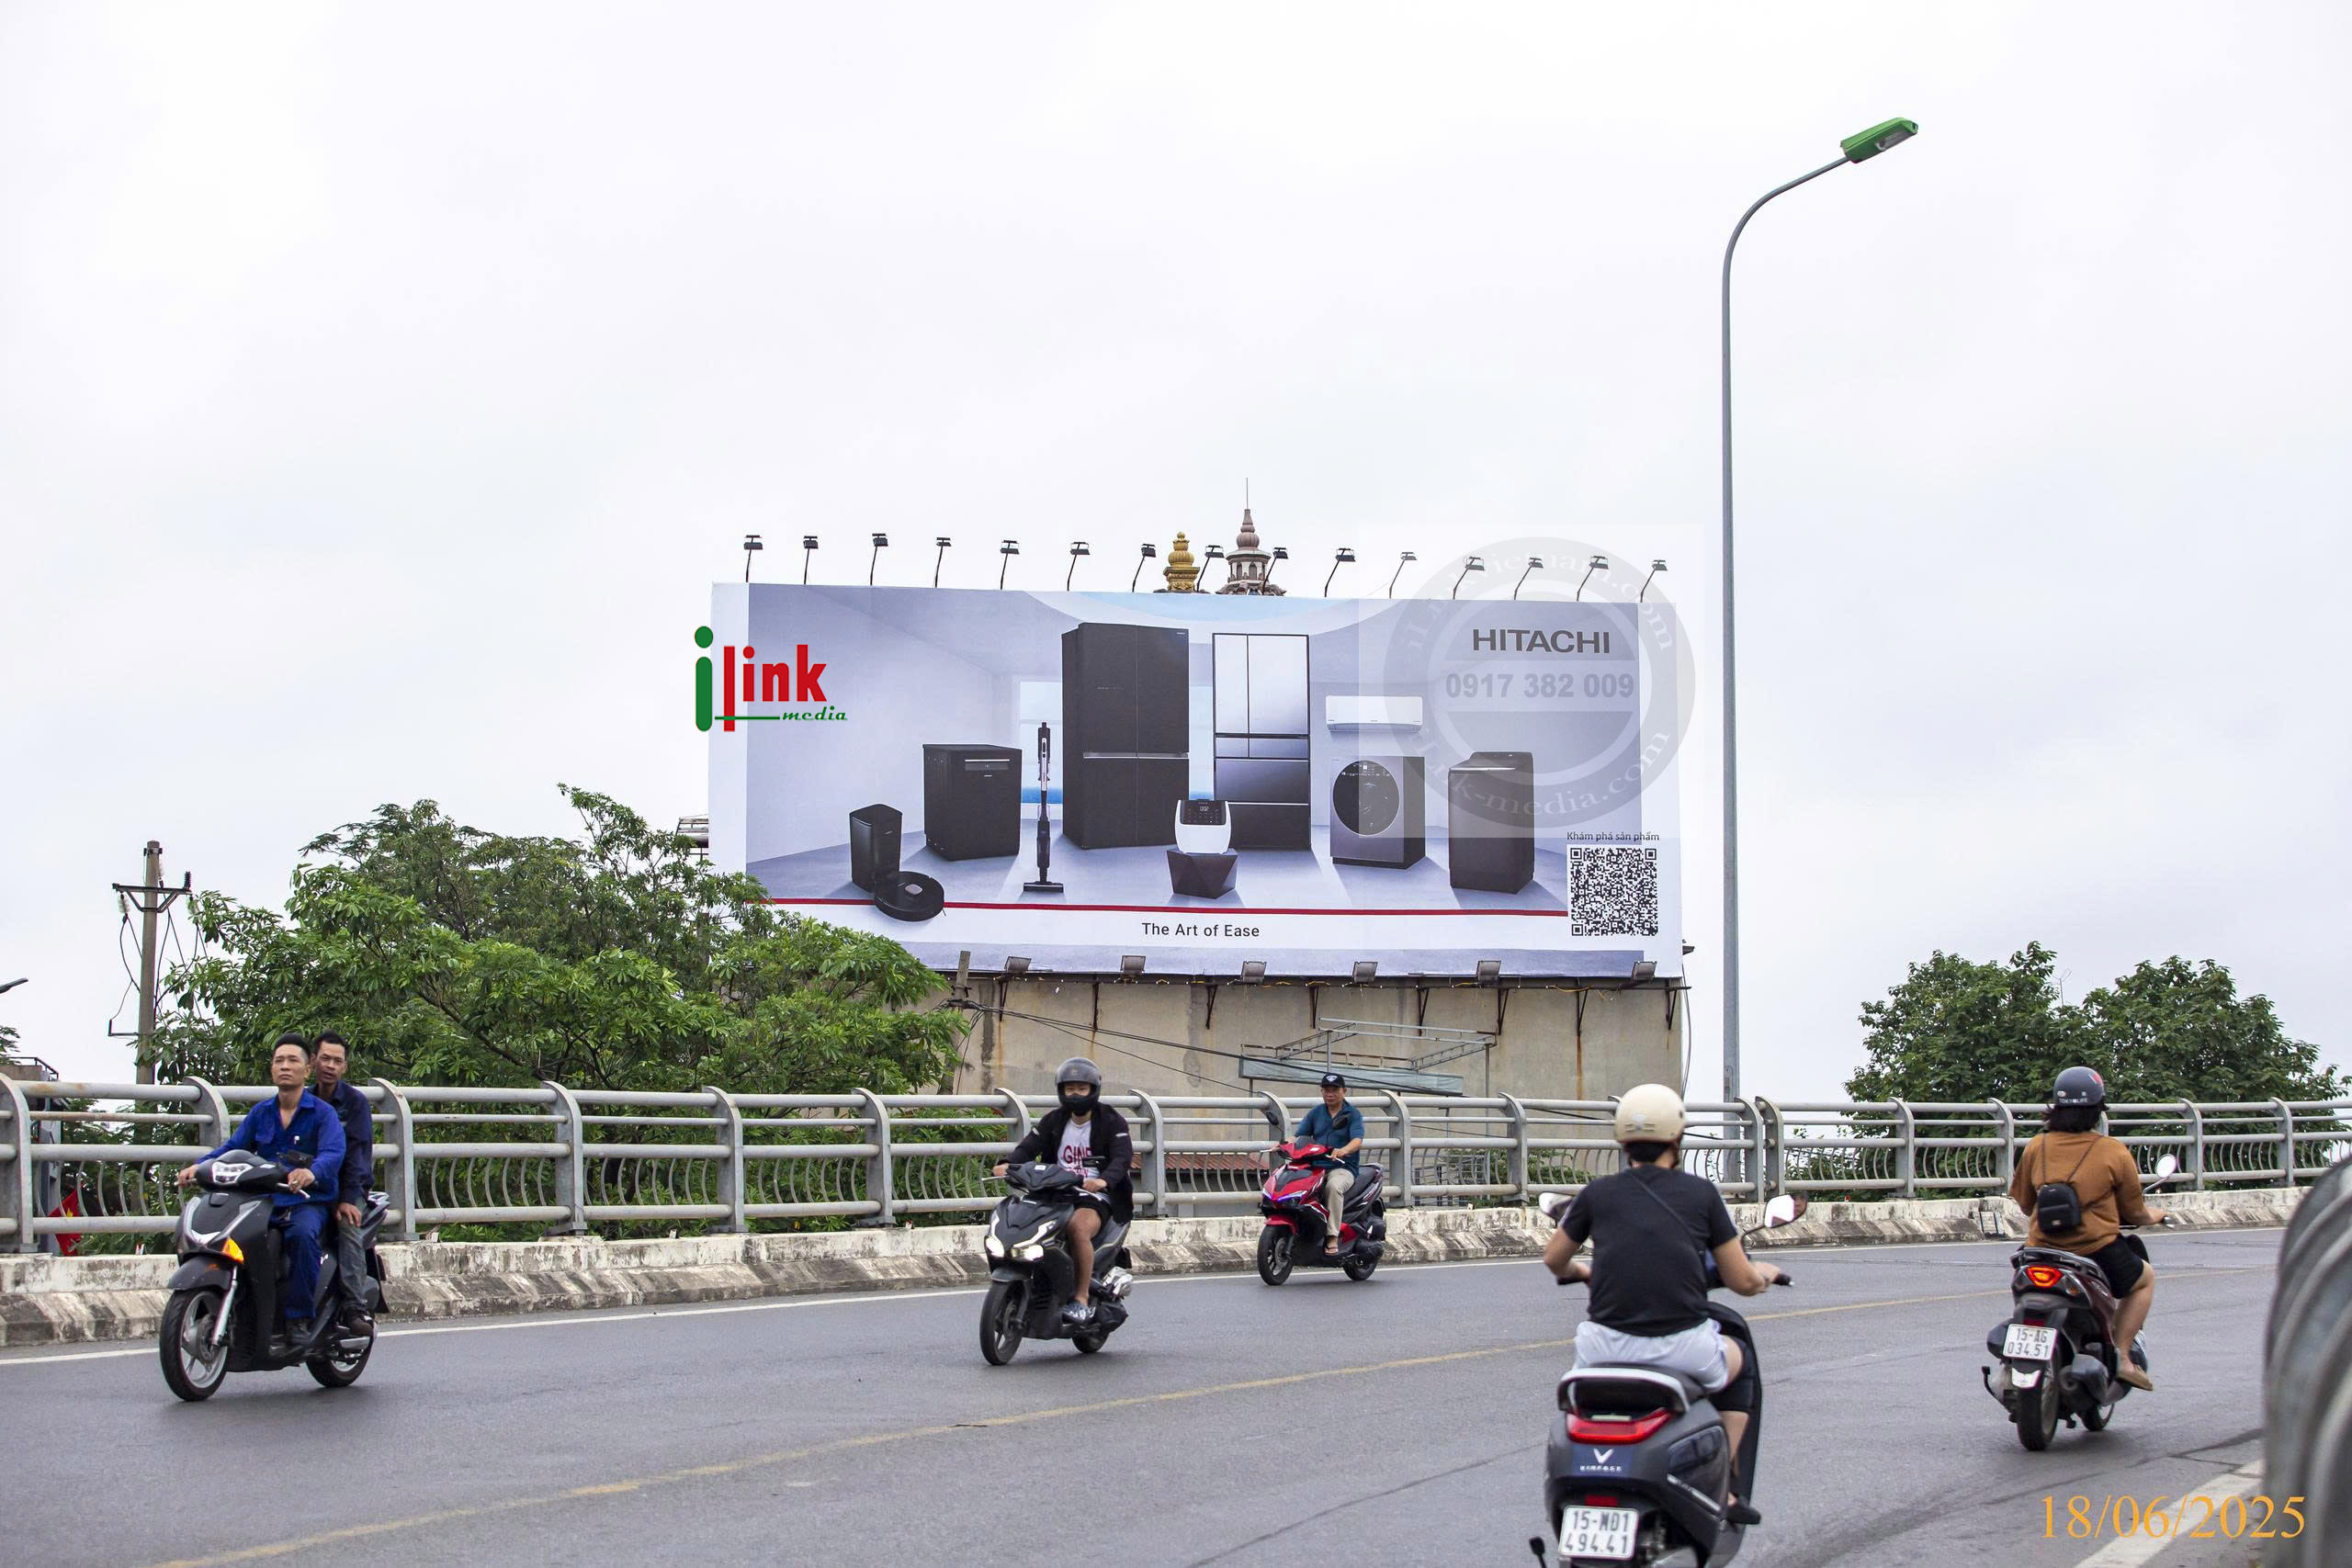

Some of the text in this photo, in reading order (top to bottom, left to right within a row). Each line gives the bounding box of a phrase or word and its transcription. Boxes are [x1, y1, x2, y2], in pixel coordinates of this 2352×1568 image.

[1473, 629, 1610, 653] HITACHI
[1566, 830, 1659, 842] Khám phá sản phẩm
[1142, 922, 1260, 937] The Art of Ease
